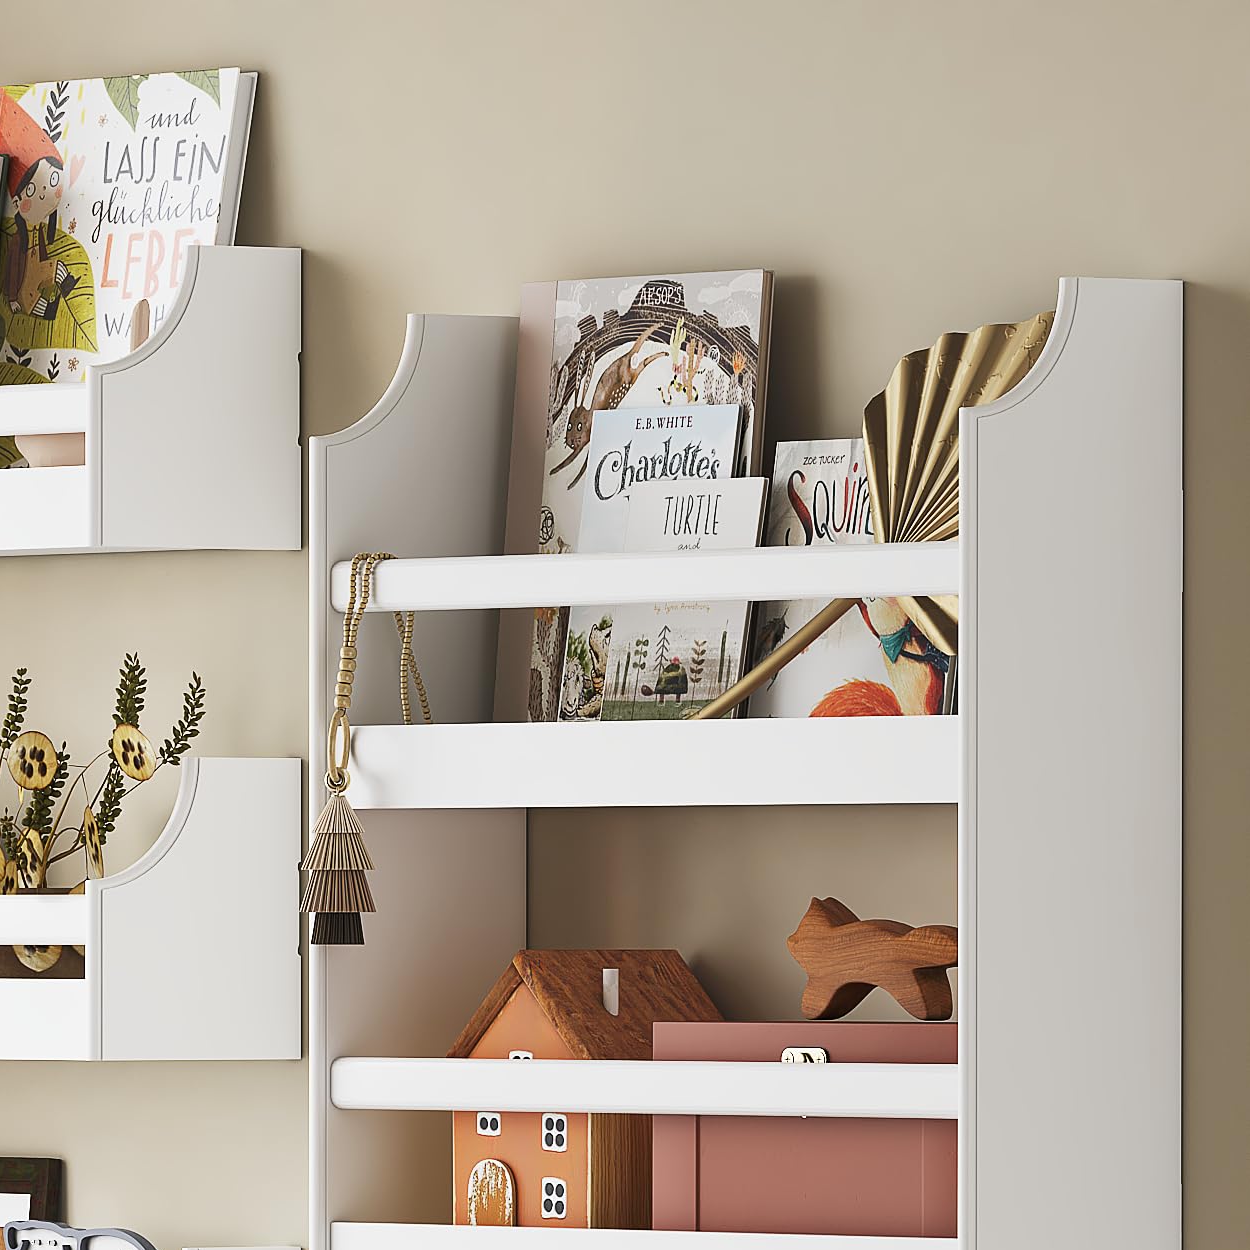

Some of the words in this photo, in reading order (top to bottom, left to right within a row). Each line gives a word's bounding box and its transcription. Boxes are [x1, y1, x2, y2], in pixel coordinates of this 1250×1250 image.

[145, 97, 200, 129] und
[103, 136, 160, 184] LASS
[100, 227, 201, 299] LEBE
[637, 286, 682, 306] AESOP'S
[594, 435, 721, 501] Charlotte's
[663, 493, 722, 535] TURTLE
[677, 537, 701, 550] and
